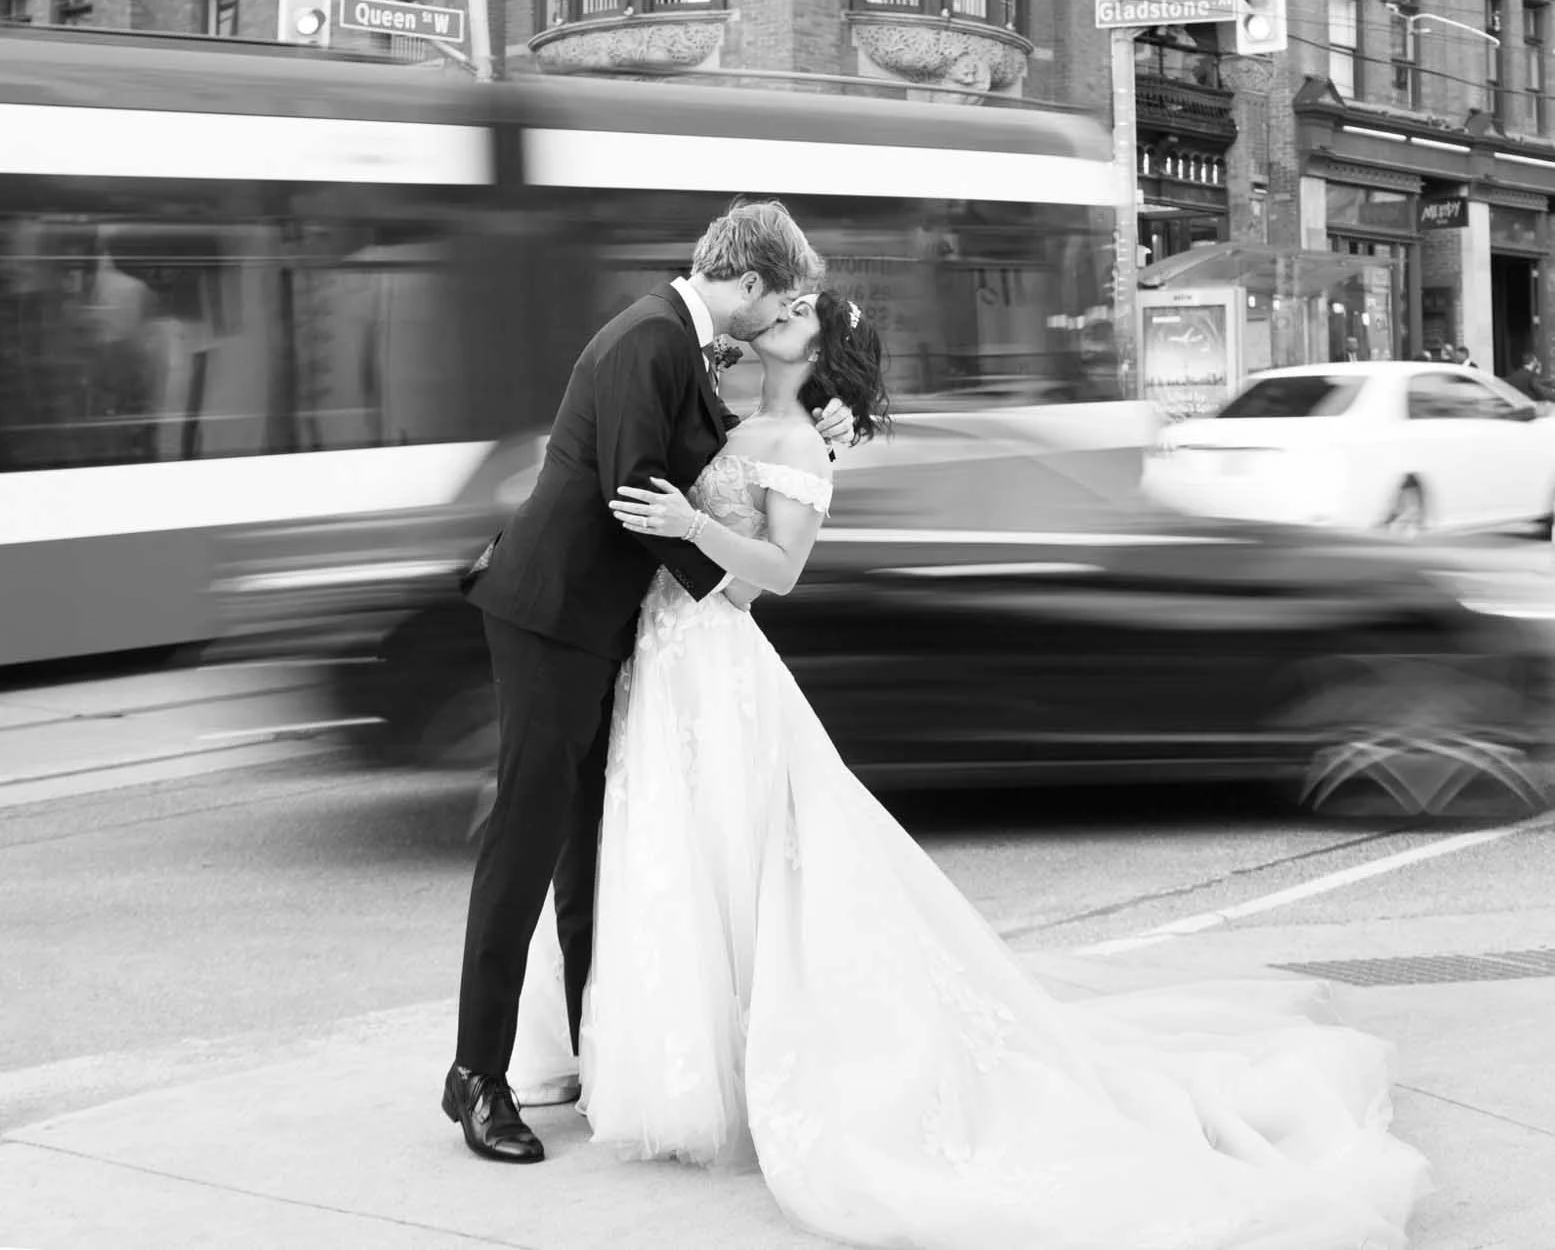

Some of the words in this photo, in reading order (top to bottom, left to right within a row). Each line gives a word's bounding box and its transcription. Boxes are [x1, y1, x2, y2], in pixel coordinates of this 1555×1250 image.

[355, 2, 416, 30] Queen
[434, 13, 449, 34] W
[1100, 0, 1209, 21] Gladstone
